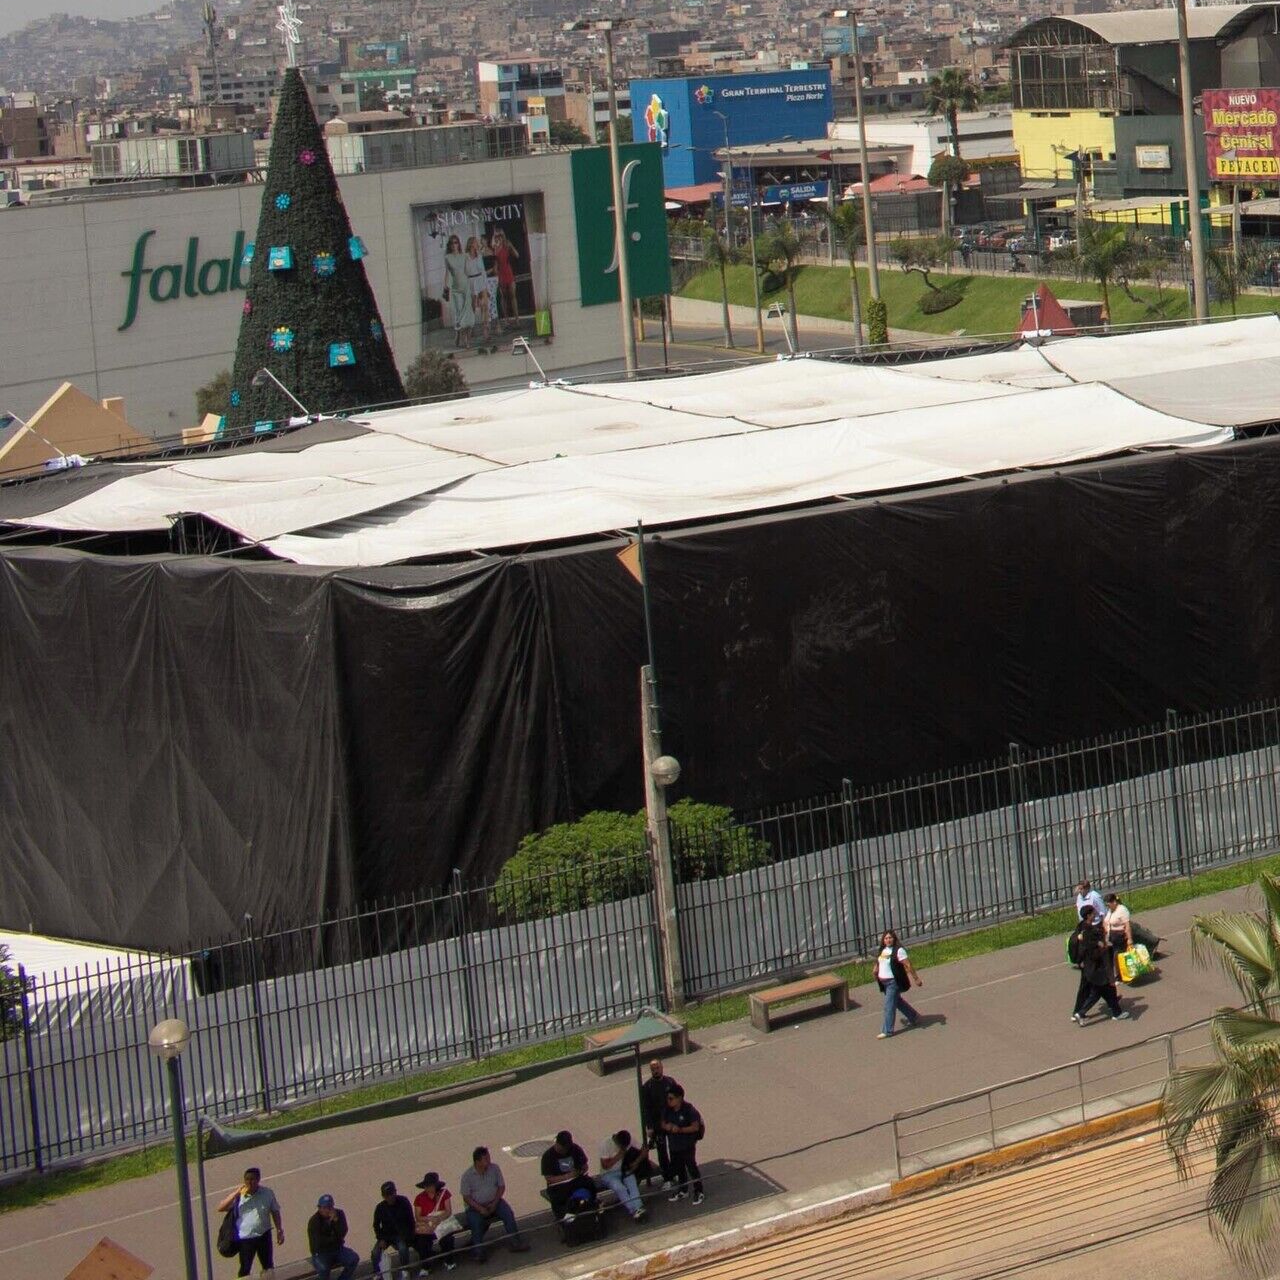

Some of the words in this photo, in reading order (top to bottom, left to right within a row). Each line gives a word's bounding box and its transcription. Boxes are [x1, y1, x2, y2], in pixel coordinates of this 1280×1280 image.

[1228, 94, 1257, 106] NUEVO
[1211, 107, 1277, 128] Mercado
[1220, 131, 1274, 151] Central
[1220, 159, 1277, 173] FEVACEL
